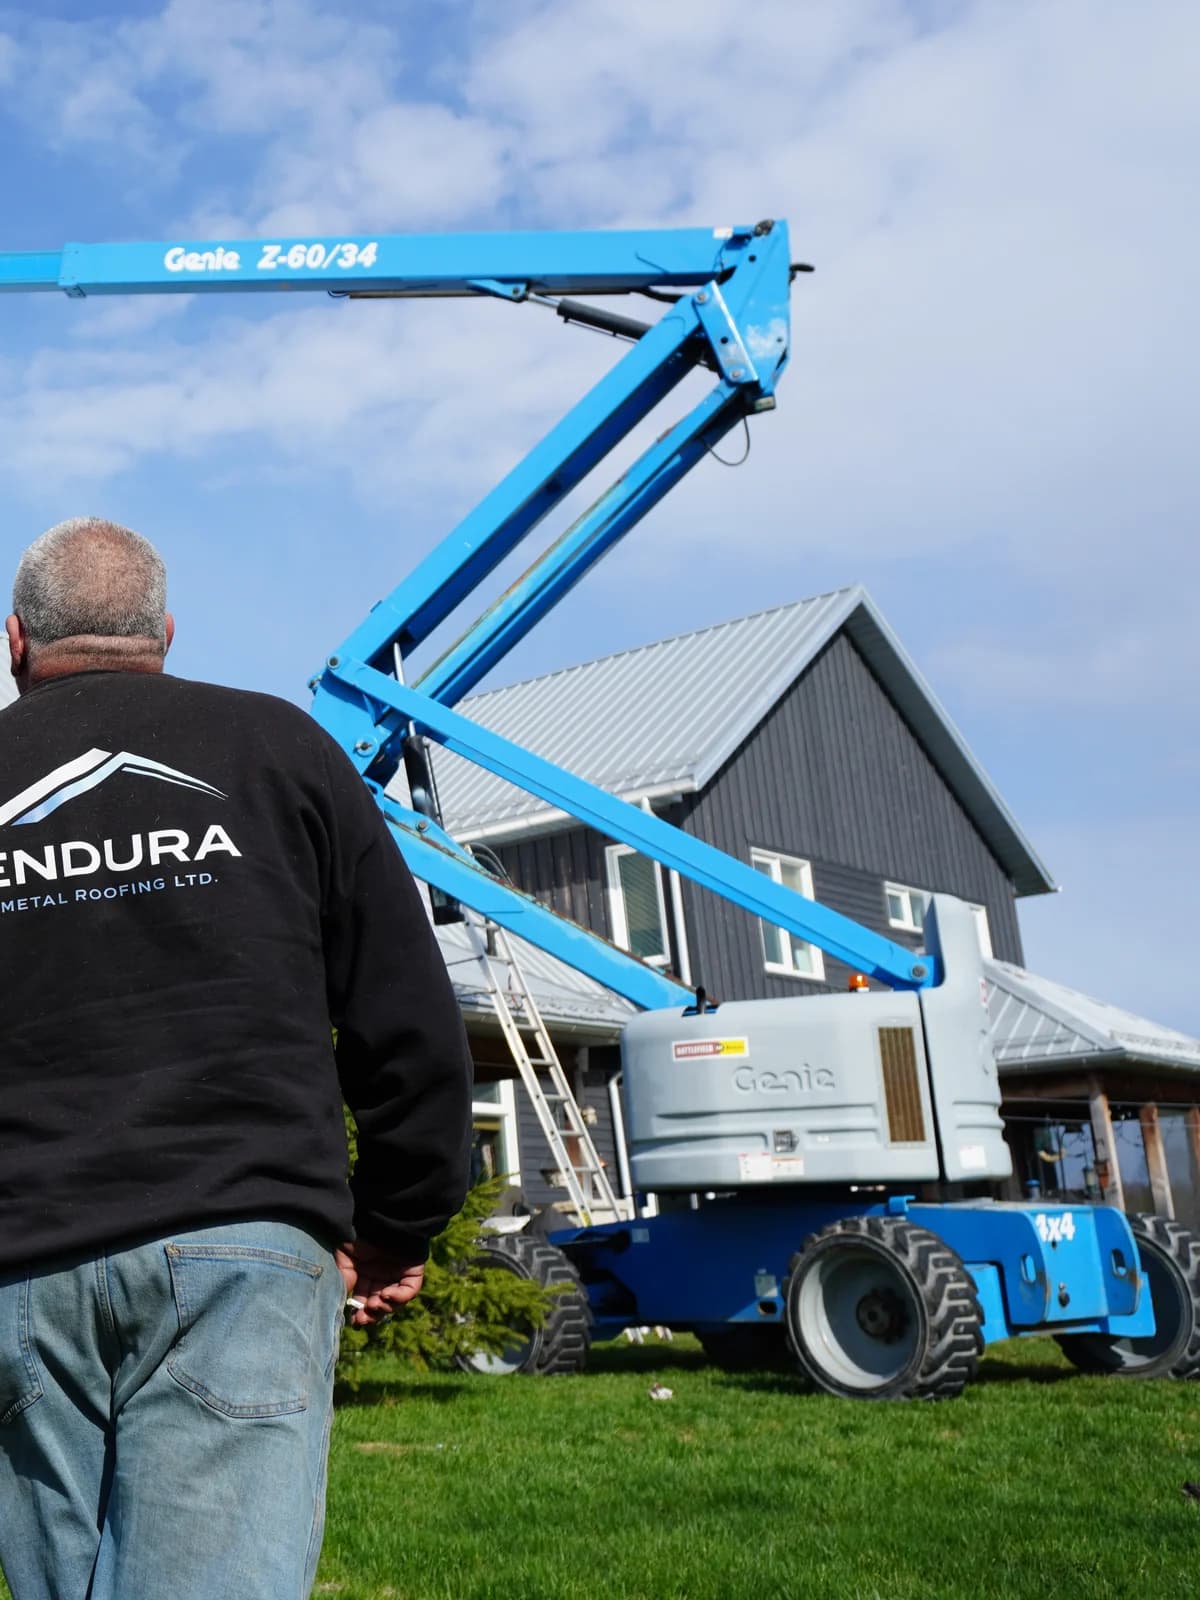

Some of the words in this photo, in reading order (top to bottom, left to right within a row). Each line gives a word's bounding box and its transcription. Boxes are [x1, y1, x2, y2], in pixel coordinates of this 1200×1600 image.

[164, 247, 240, 272] Genie
[257, 242, 378, 269] Z-60/34
[1, 893, 68, 913] METAL
[75, 878, 166, 901] ROOFING
[174, 872, 218, 888] LTD.
[735, 1063, 836, 1091] Genie
